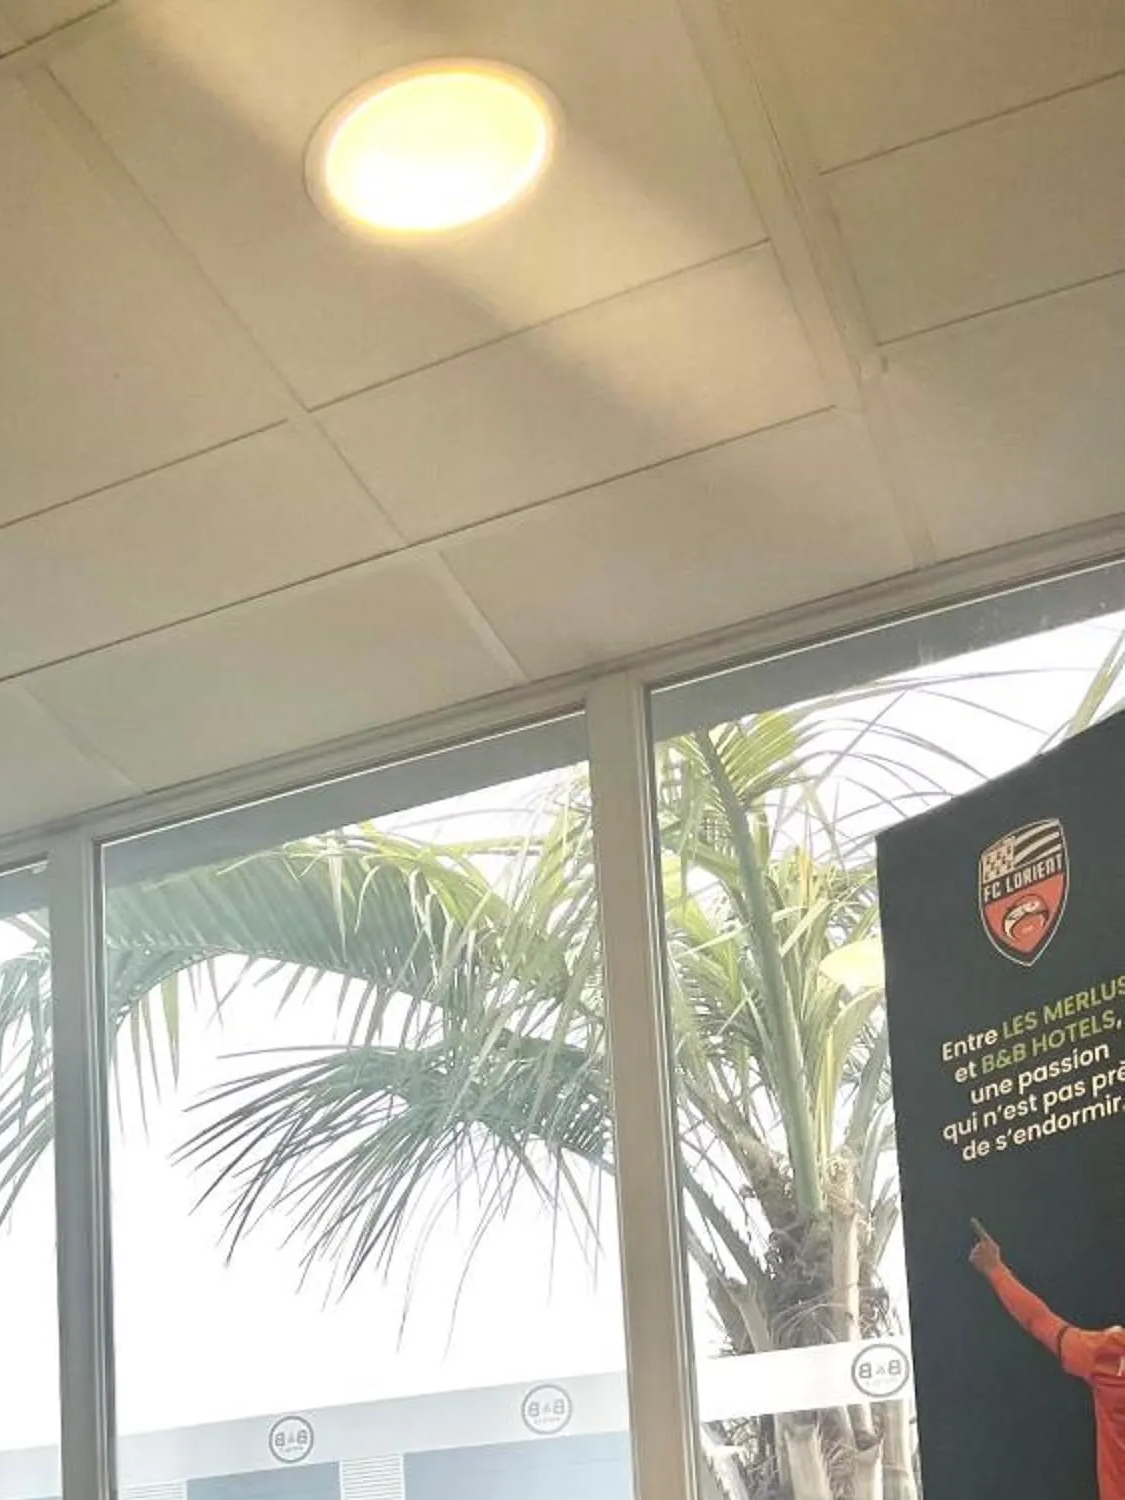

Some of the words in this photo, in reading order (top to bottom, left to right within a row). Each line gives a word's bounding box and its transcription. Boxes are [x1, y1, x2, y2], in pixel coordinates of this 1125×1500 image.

[984, 881, 1002, 904] FC
[1006, 853, 1062, 894] LORIENT
[941, 1028, 998, 1062] Entre
[1002, 1010, 1038, 1040] LES
[954, 1060, 977, 1083] et
[981, 1042, 1027, 1075] B&B
[1031, 1009, 1122, 1057] HOTELS,
[970, 1078, 1013, 1105] une
[1018, 1043, 1109, 1095] passion
[942, 1111, 978, 1144] qui
[1042, 1080, 1086, 1114] pas
[962, 1140, 990, 1161] de
